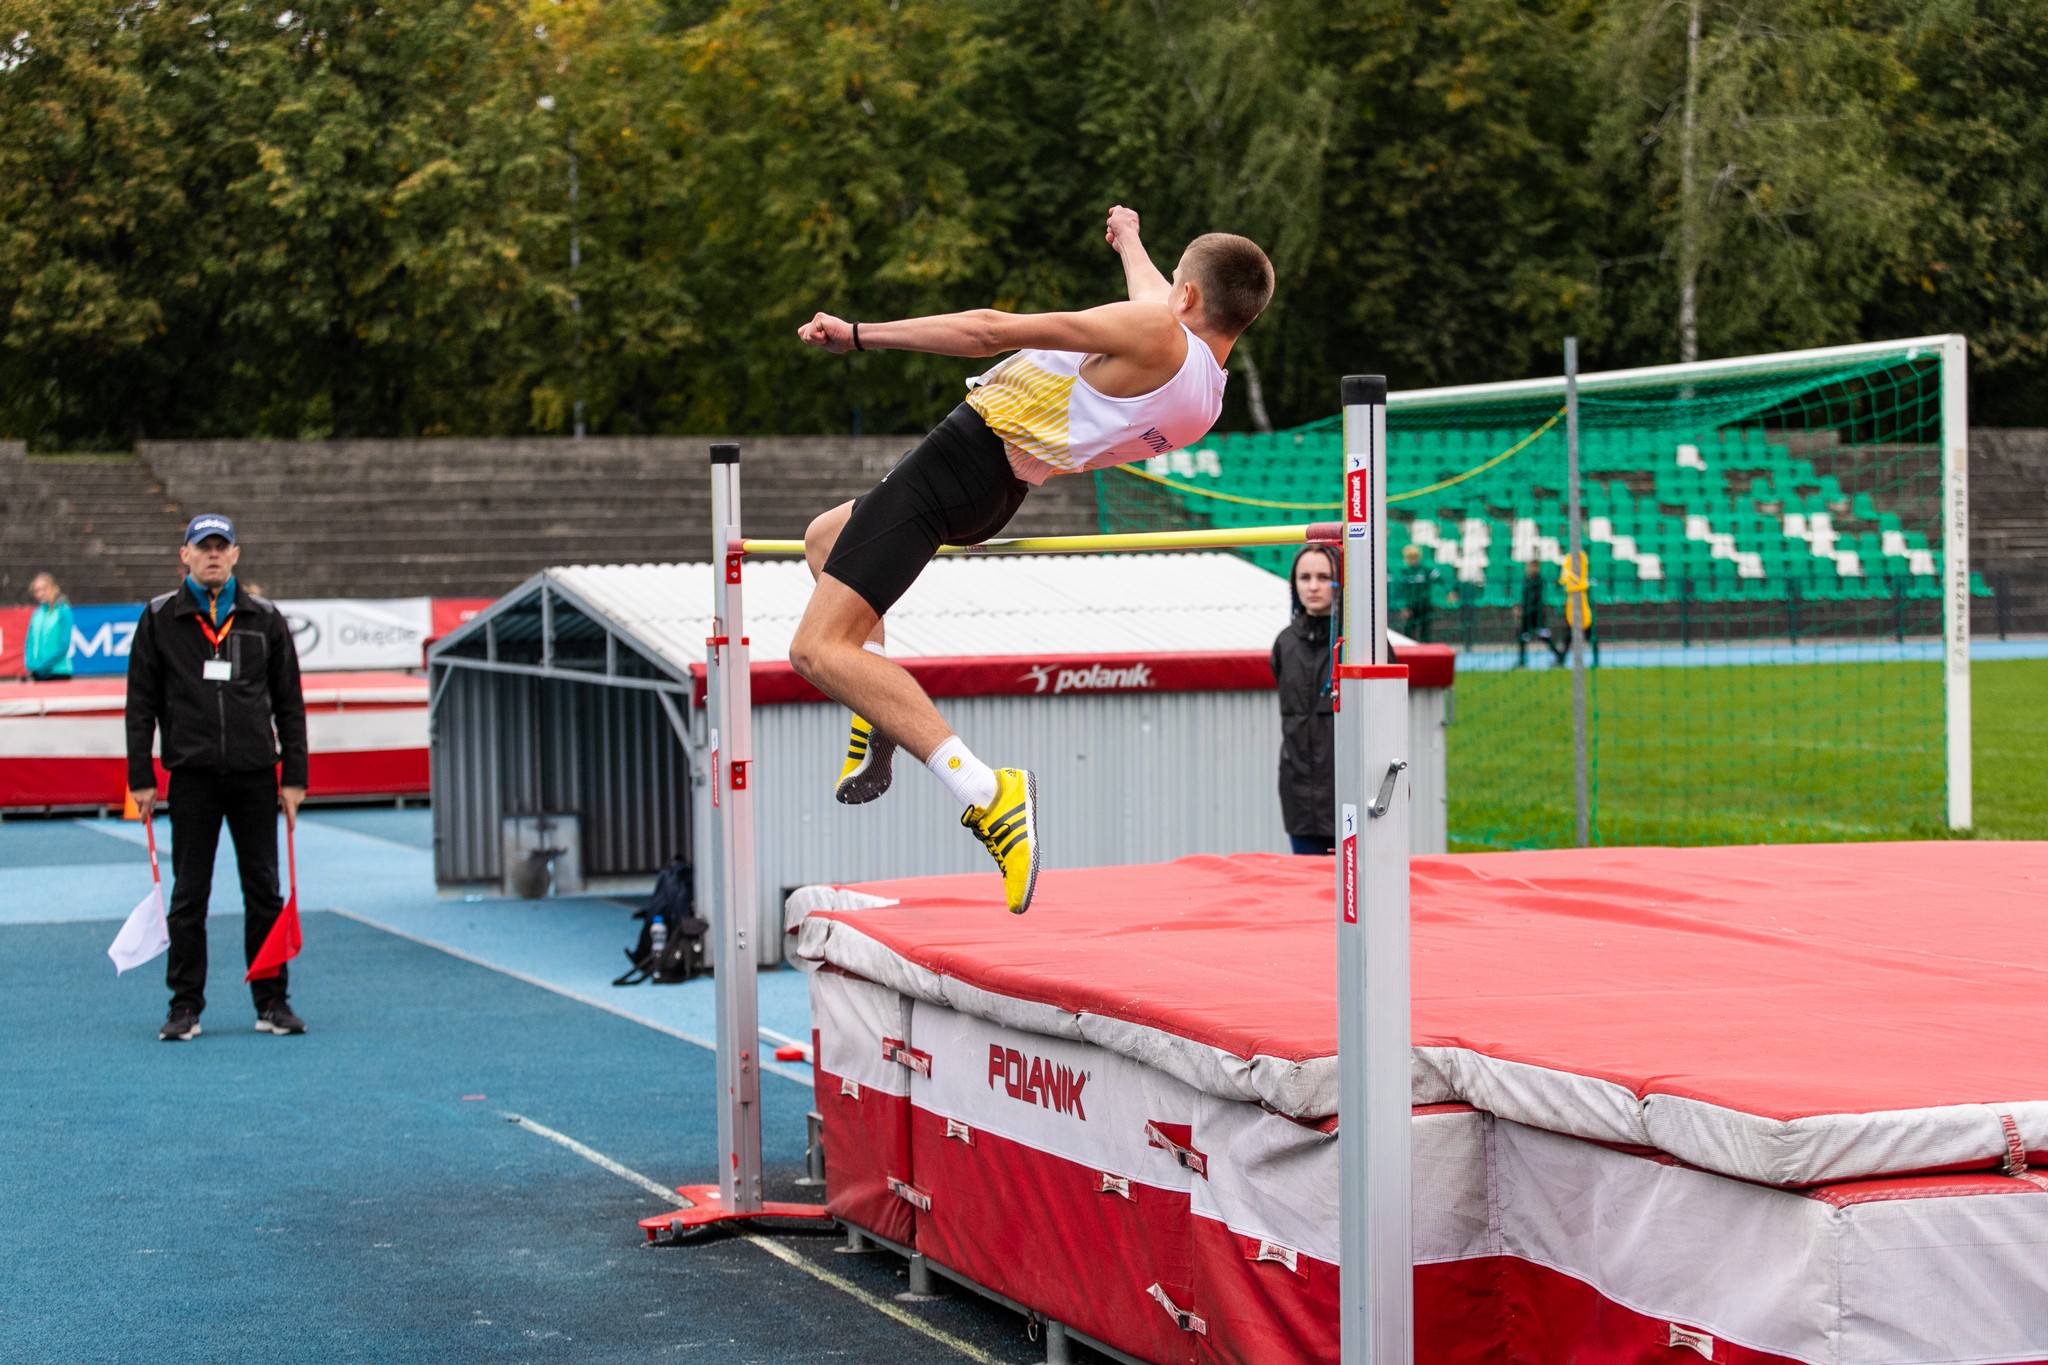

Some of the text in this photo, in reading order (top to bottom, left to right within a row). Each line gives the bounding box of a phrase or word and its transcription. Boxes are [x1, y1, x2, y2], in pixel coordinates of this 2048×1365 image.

[1351, 476, 1363, 518] polanik
[194, 519, 230, 532] adidas
[1054, 662, 1153, 694] polanik
[1346, 844, 1355, 919] polanik
[988, 1043, 1087, 1122] POLANIK
